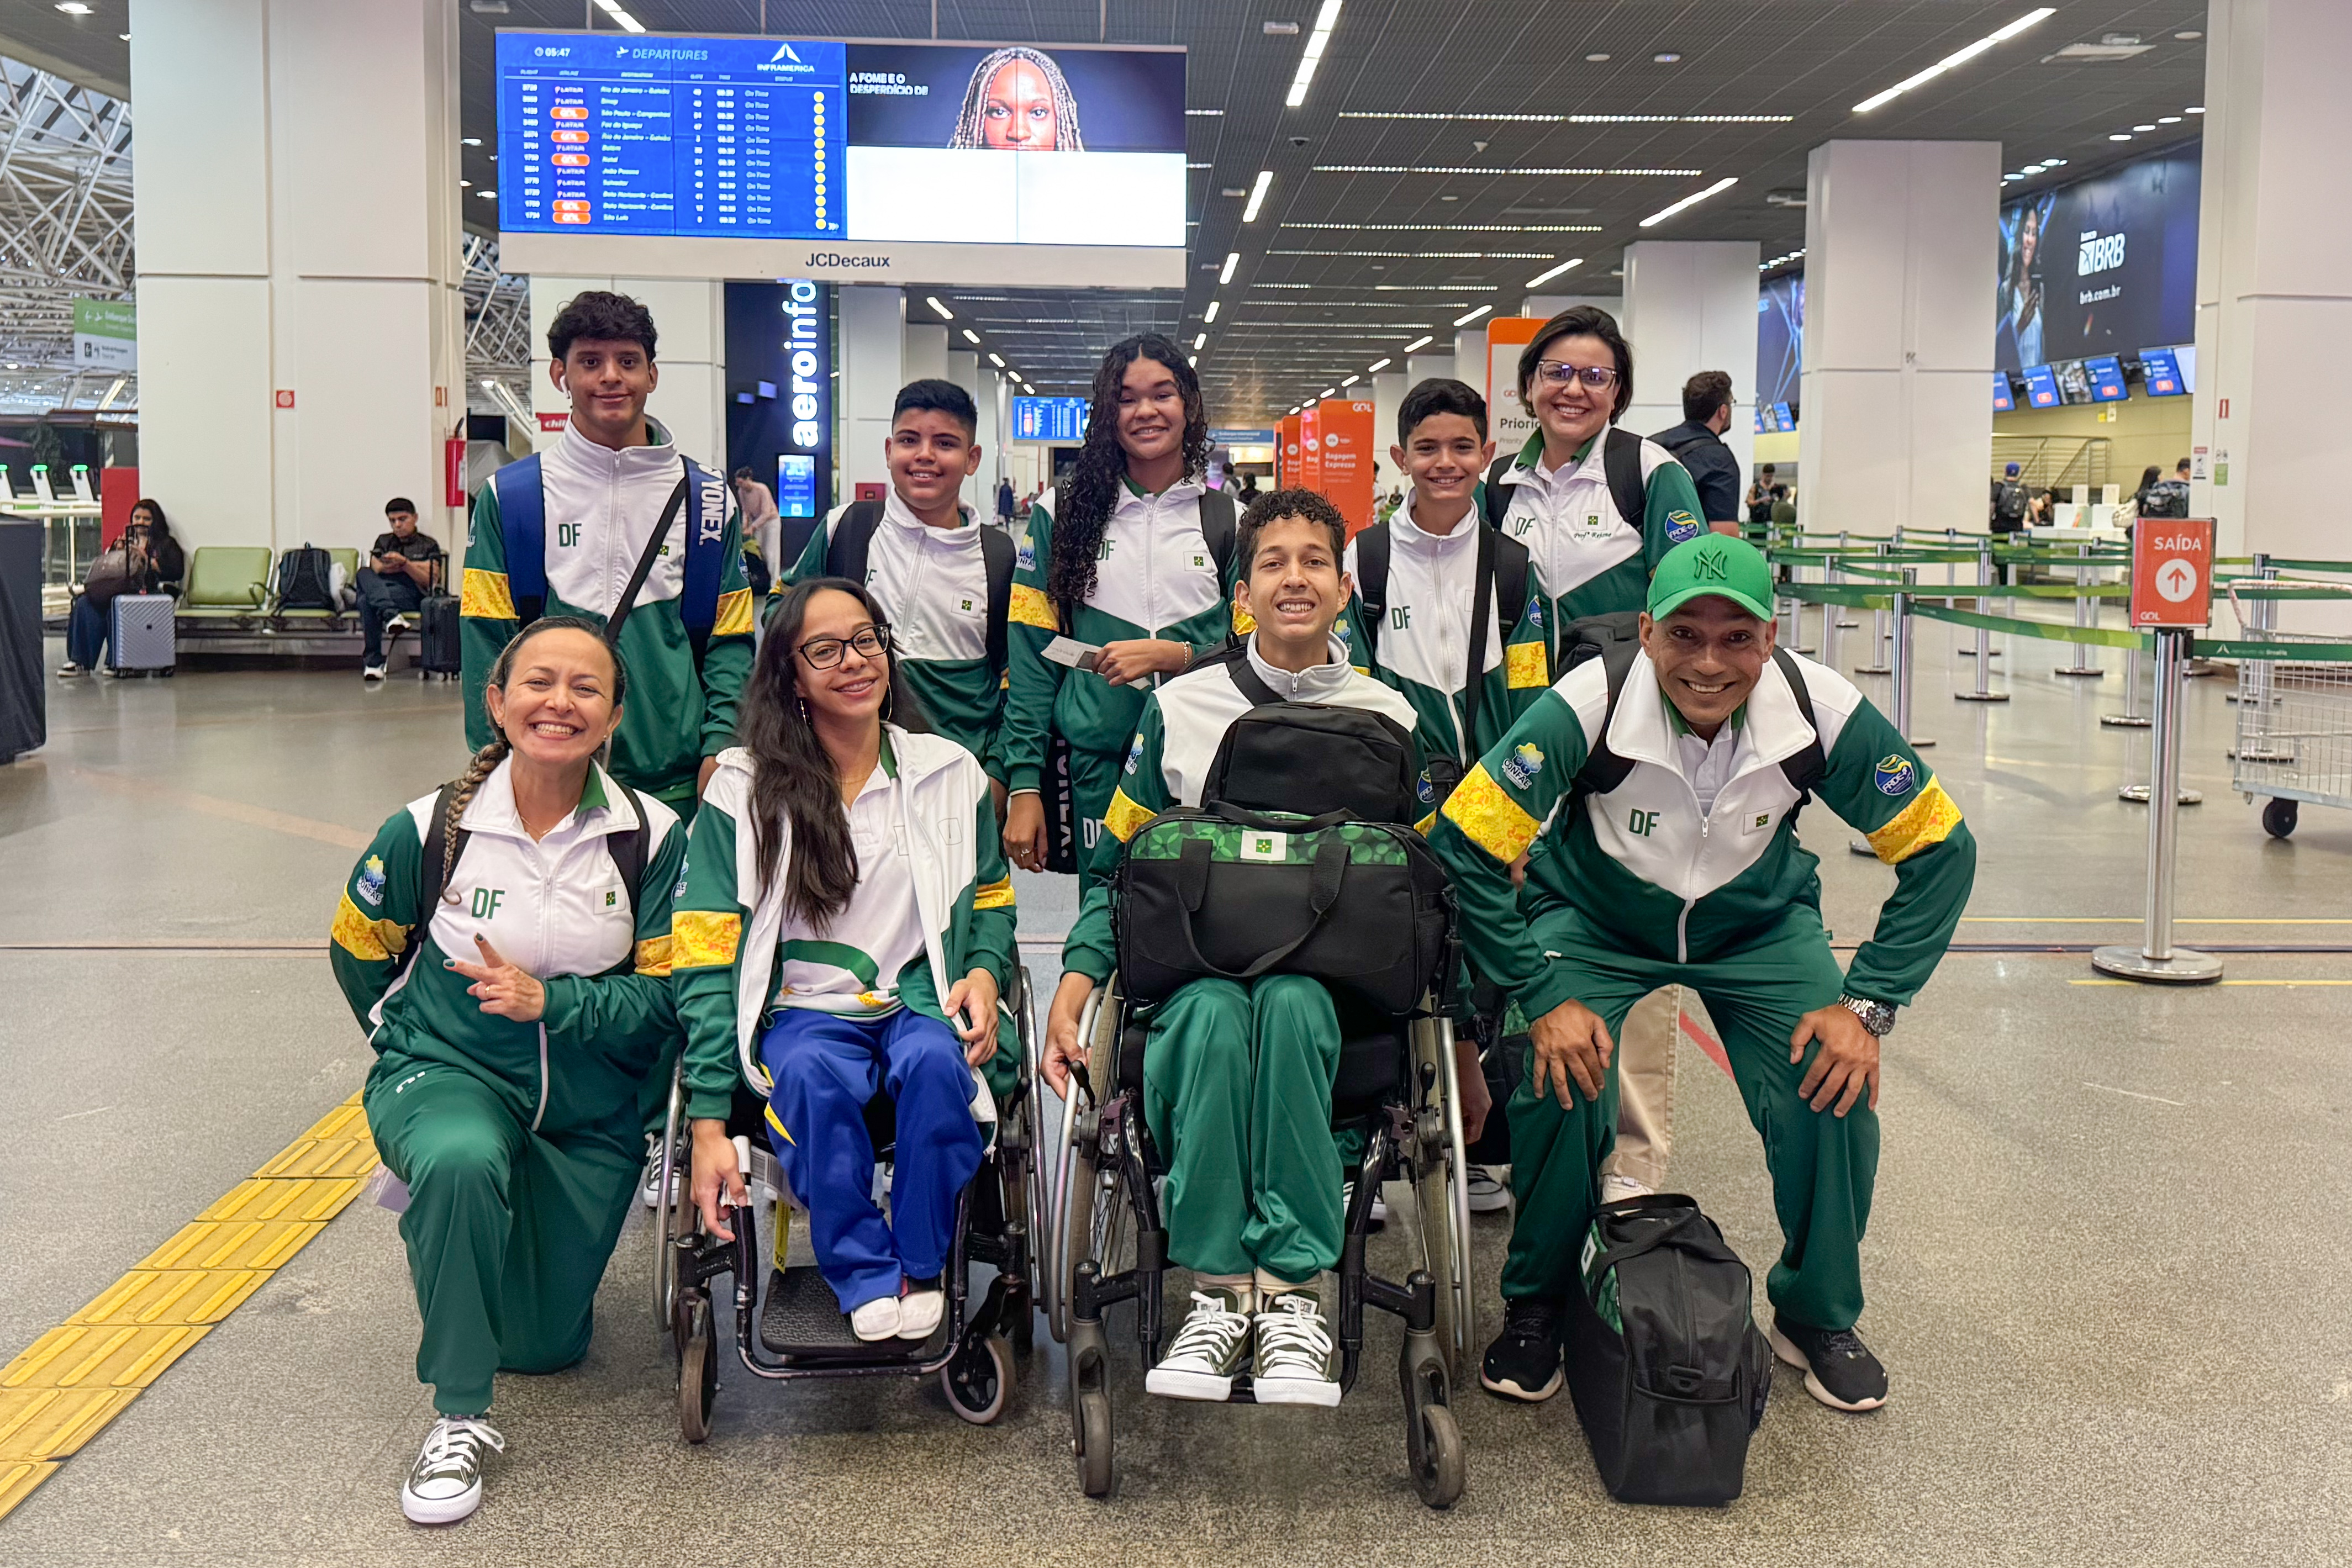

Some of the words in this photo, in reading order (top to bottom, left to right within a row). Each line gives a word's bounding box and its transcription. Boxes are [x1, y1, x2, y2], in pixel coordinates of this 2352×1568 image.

[632, 48, 708, 61] DEPARTURES
[757, 64, 815, 72] INFRAMERICA
[850, 72, 858, 83] A
[858, 72, 887, 84] FOME
[888, 73, 895, 84] E
[896, 73, 906, 85] O
[850, 83, 914, 95] DESPERDÍCIO
[805, 253, 890, 268] JCDecaux
[2093, 233, 2126, 272] BRB
[782, 281, 819, 447] aeroinfo
[1352, 402, 1373, 412] GOL
[1325, 452, 1357, 461] Bagagem
[700, 480, 724, 543] YONEX
[558, 523, 582, 547] DF
[1515, 517, 1536, 536] DF
[2154, 534, 2202, 551] SAÍDA
[1694, 547, 1728, 580] NY
[1391, 605, 1411, 630] DF
[2139, 611, 2160, 621] GOL
[1504, 758, 1531, 788] CONFAE
[1629, 808, 1660, 837] DF
[471, 887, 505, 920] DF
